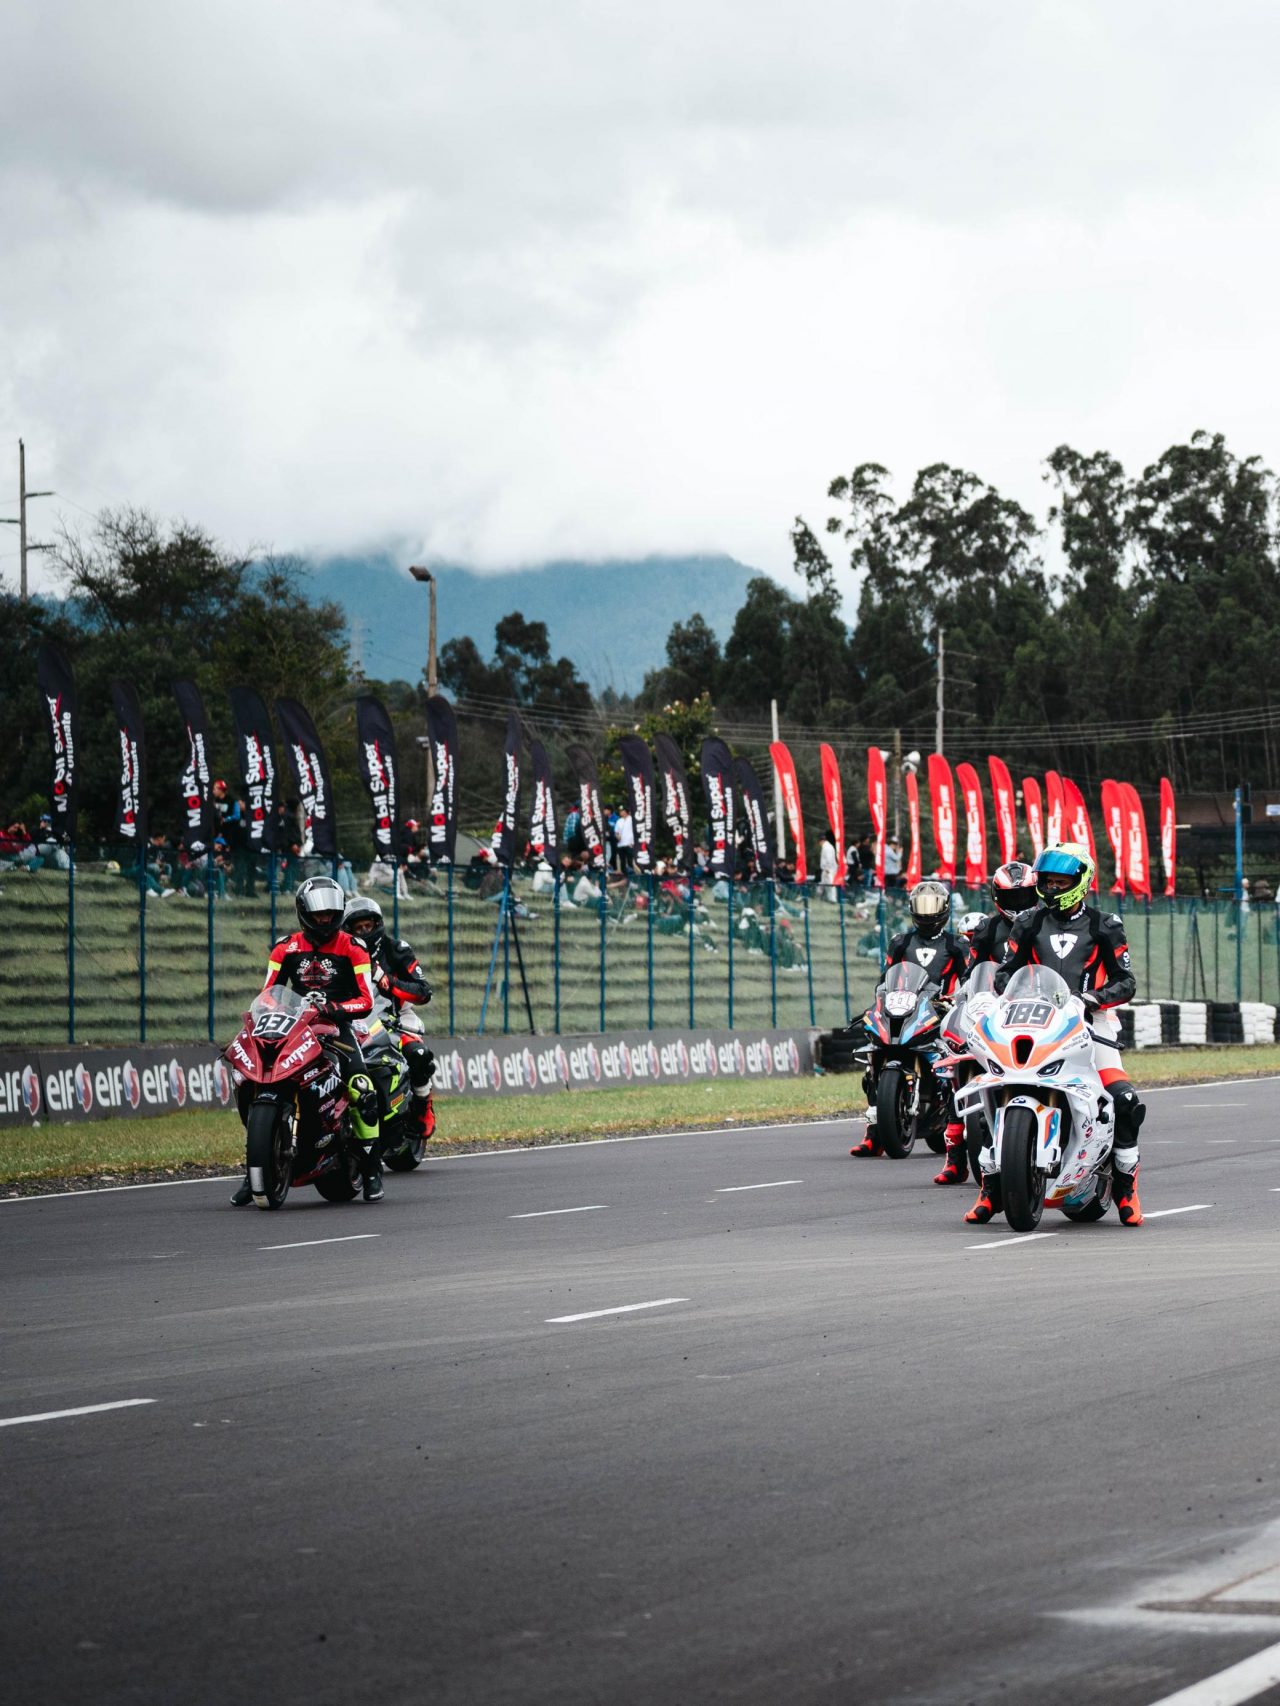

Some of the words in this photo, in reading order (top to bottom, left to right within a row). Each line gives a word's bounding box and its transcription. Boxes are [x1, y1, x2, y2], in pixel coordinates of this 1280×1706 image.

[46, 693, 64, 754] Super
[120, 730, 133, 785] Super
[244, 734, 261, 784] Super
[292, 744, 313, 795] Super
[363, 742, 385, 792] Super
[435, 741, 448, 792] Super
[54, 757, 68, 812] Mobil
[532, 781, 545, 823] Super
[631, 775, 645, 821] Super
[664, 772, 678, 815] Super
[706, 773, 725, 819] Super
[120, 787, 136, 837] Mobil
[249, 785, 264, 838] Mobil
[315, 804, 326, 819] 4T
[373, 795, 391, 844] Mobil
[430, 792, 446, 842] Mobil
[711, 821, 725, 864] Mobil
[253, 1013, 298, 1035] 931
[1005, 1002, 1054, 1026] 189
[46, 1069, 75, 1110] elf
[95, 1066, 123, 1107] elf
[142, 1064, 170, 1104] elf
[188, 1063, 214, 1102] elf
[432, 1055, 453, 1089] elf
[467, 1054, 488, 1088] elf
[503, 1052, 524, 1086] elf
[537, 1049, 558, 1083] elf
[570, 1047, 590, 1080] elf
[601, 1045, 621, 1078] elf
[631, 1045, 649, 1077] elf
[660, 1043, 678, 1075] elf
[690, 1043, 707, 1074] elf
[718, 1043, 735, 1073] elf
[746, 1042, 763, 1073] elf
[773, 1041, 790, 1072] elf
